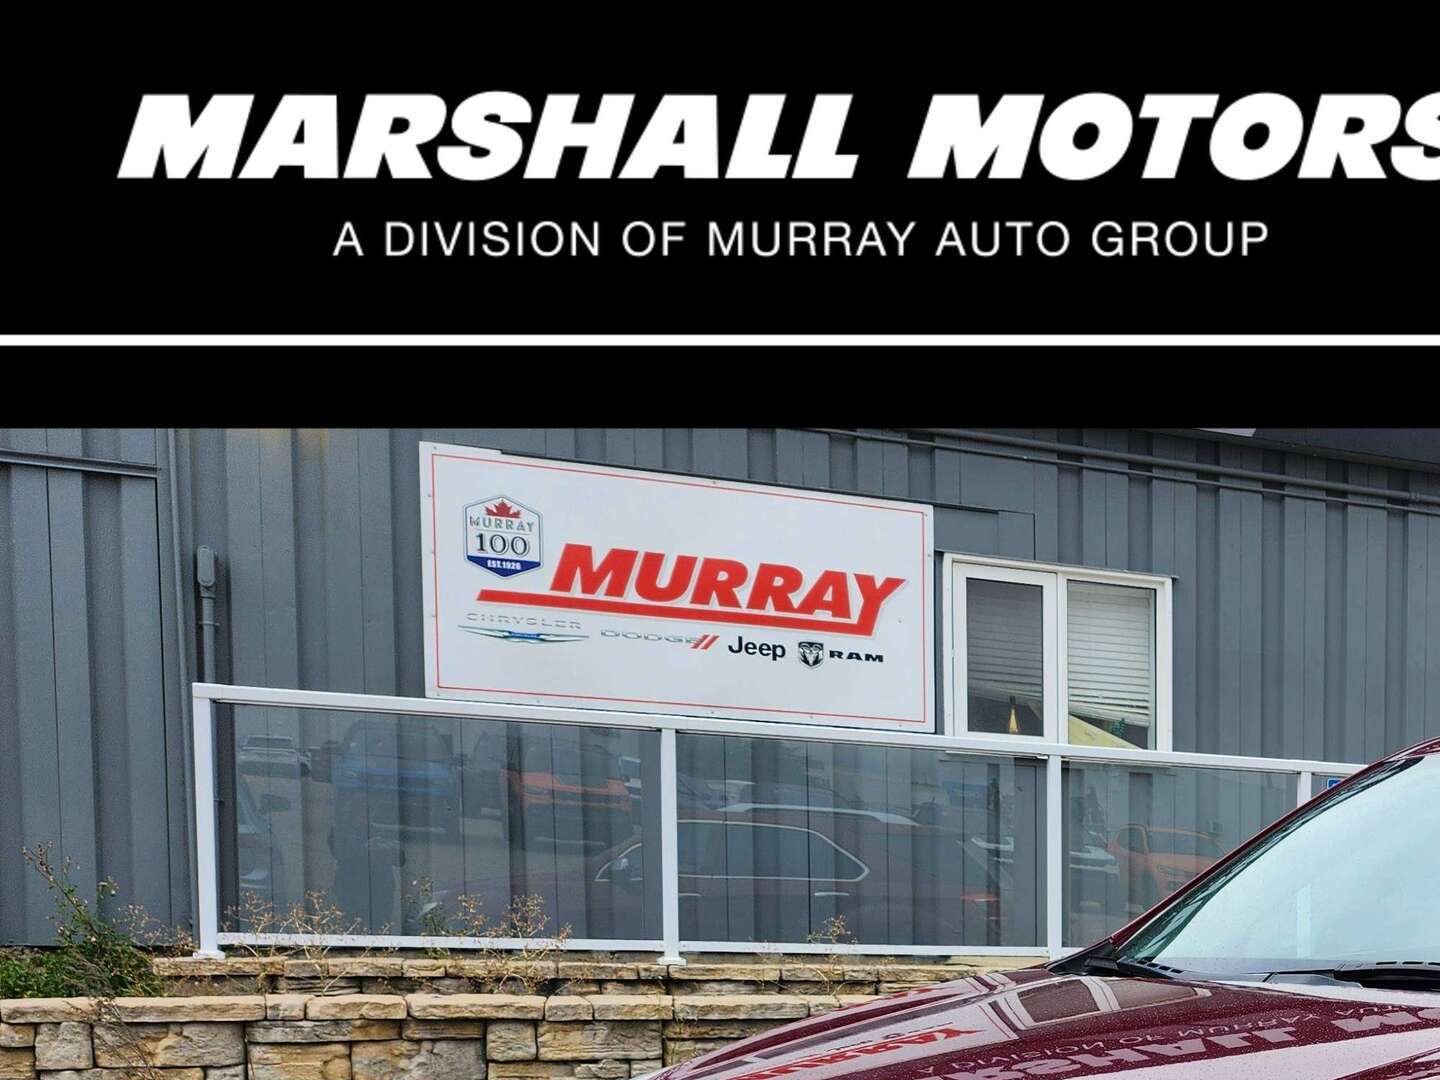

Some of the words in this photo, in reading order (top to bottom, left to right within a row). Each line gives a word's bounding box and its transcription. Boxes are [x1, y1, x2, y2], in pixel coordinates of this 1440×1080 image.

[469, 515, 535, 533] MURRAY
[475, 532, 530, 556] 100
[549, 542, 906, 636] MURRAY
[465, 612, 582, 630] CHRYSLER
[600, 629, 703, 645] DODGE
[728, 635, 787, 662] Jeep
[829, 650, 884, 664] RAM
